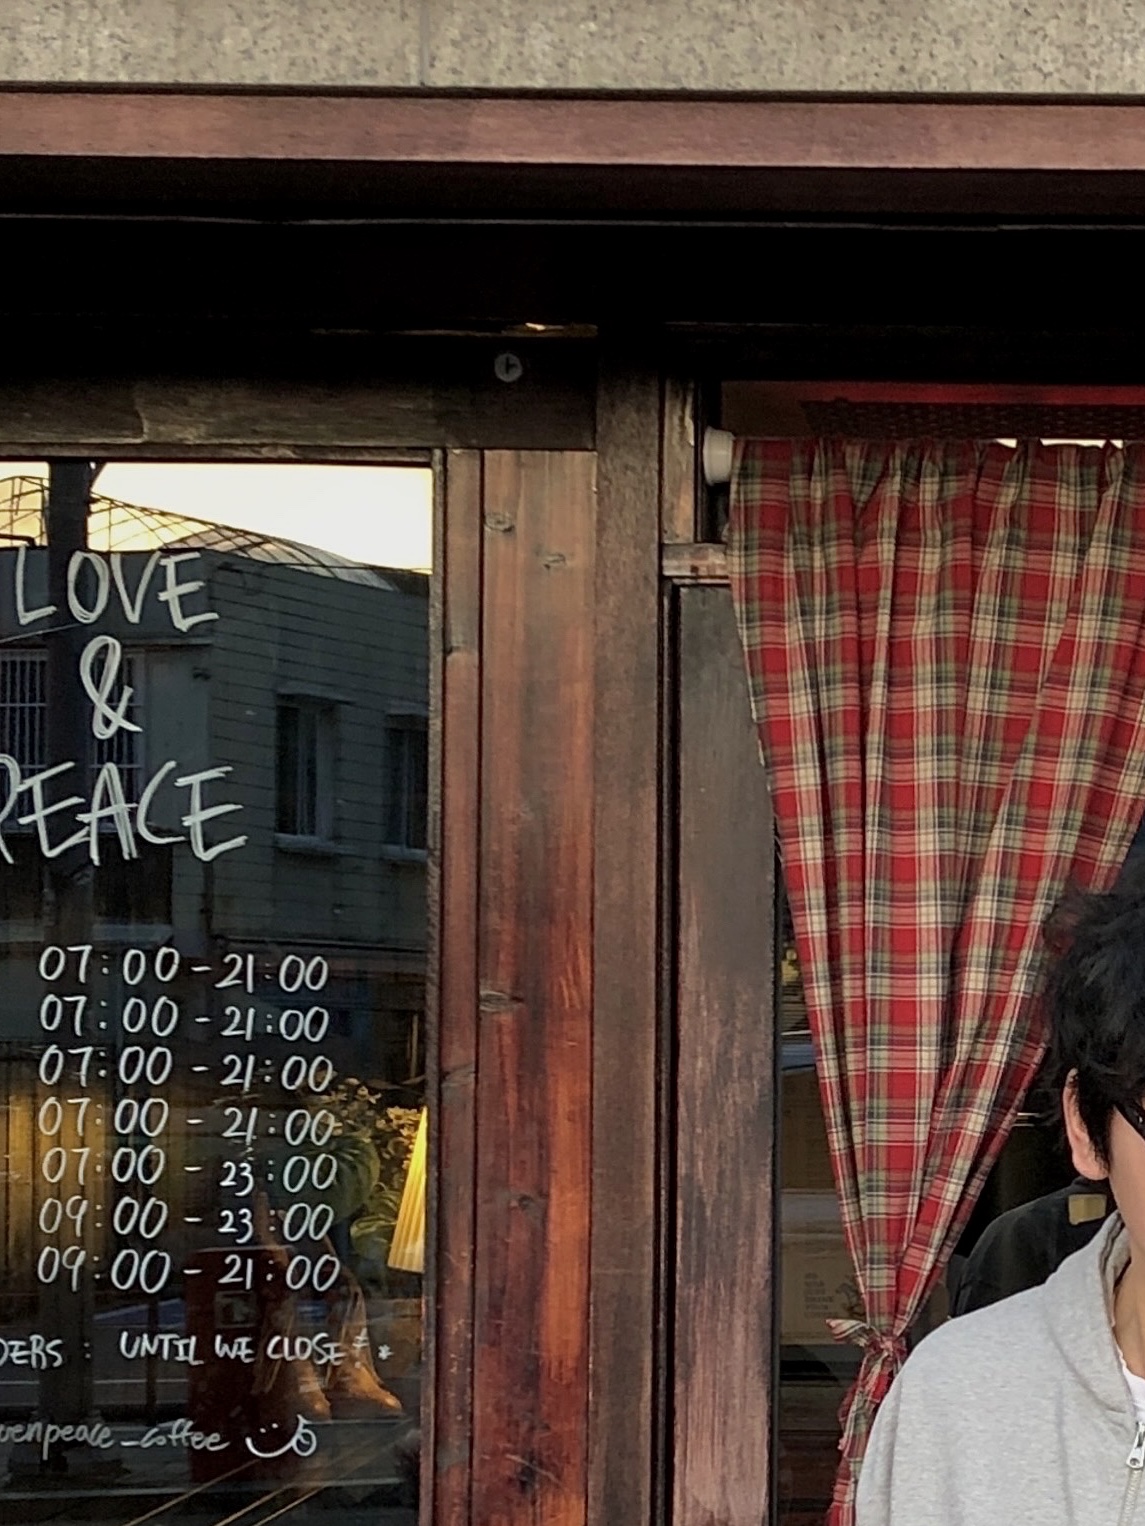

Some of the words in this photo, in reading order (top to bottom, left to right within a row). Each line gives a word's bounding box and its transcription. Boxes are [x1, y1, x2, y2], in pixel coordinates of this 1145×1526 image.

[15, 544, 219, 632] LOVE
[79, 634, 142, 740] &
[39, 944, 180, 986] 07:00
[215, 953, 329, 993] 21:00
[40, 994, 178, 1037] 07:00
[220, 1006, 329, 1042] 21:00
[39, 1044, 172, 1087] 07:00
[220, 1054, 334, 1093] 21:00
[38, 1096, 169, 1138] 07:00
[222, 1107, 336, 1147] 21:00
[42, 1144, 166, 1186] 07:00
[219, 1153, 338, 1197] 23:00
[38, 1195, 168, 1240] 09:00
[218, 1202, 335, 1244] 23:00
[37, 1245, 171, 1294] 09:00
[218, 1254, 340, 1292] 21:00
[119, 1331, 204, 1366] UNTIL
[215, 1335, 255, 1364] WE
